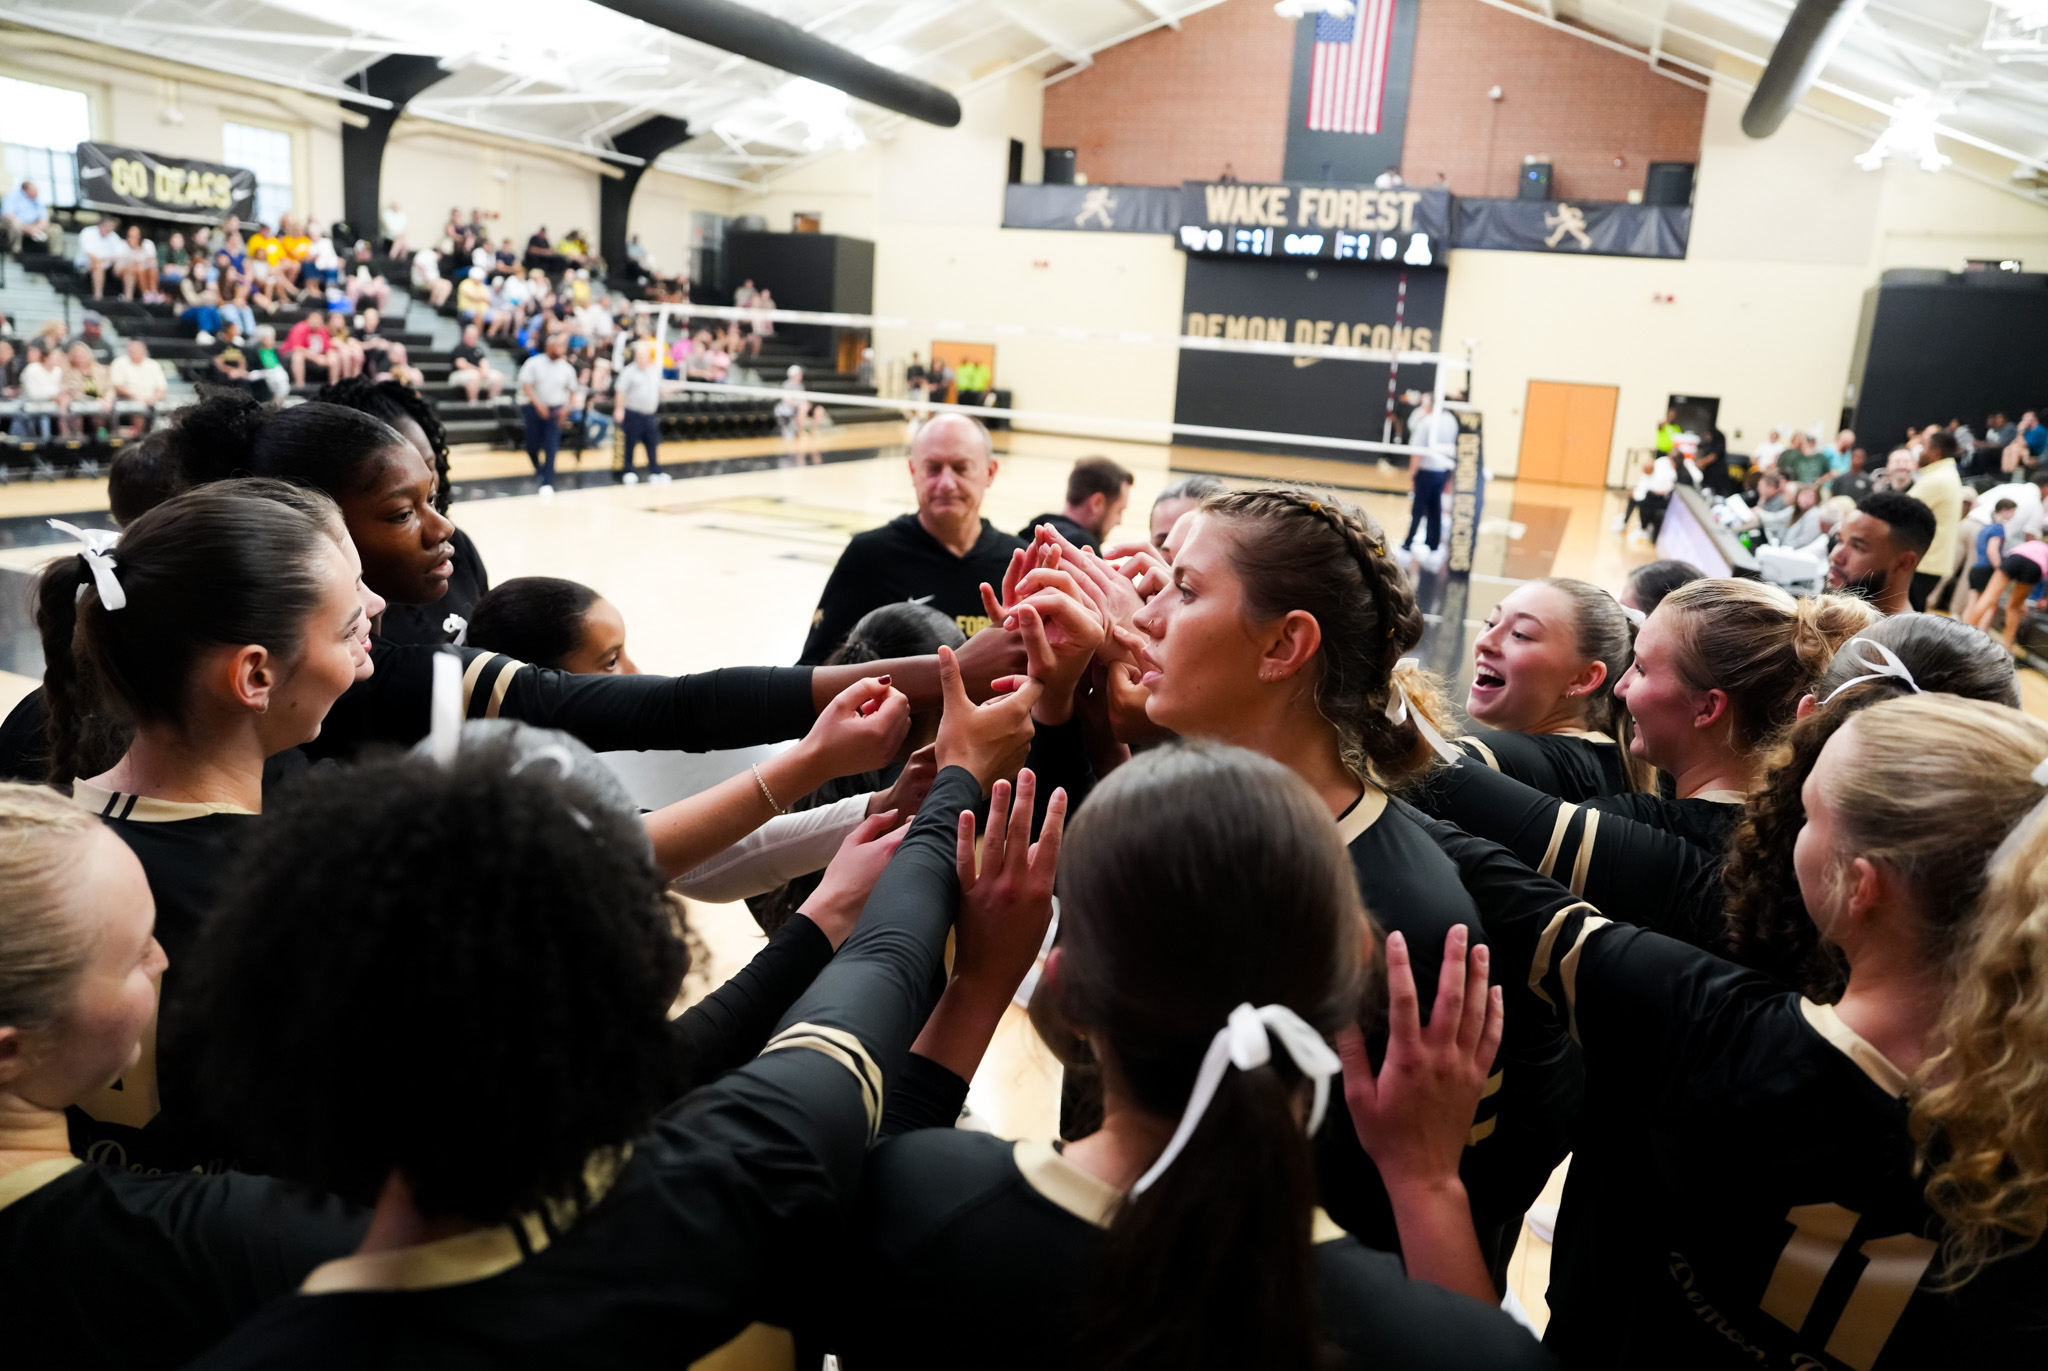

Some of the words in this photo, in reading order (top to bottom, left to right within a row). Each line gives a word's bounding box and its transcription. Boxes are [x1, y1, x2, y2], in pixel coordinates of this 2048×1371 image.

[111, 157, 148, 198] GO
[154, 164, 232, 209] DEACS
[1205, 184, 1291, 227] WAKE
[1298, 188, 1421, 232] FOREST
[1188, 312, 1287, 343] DEMON
[1294, 318, 1433, 352] DEACONS
[1667, 1250, 1769, 1369] Demon
[1758, 1201, 1940, 1371] 11
